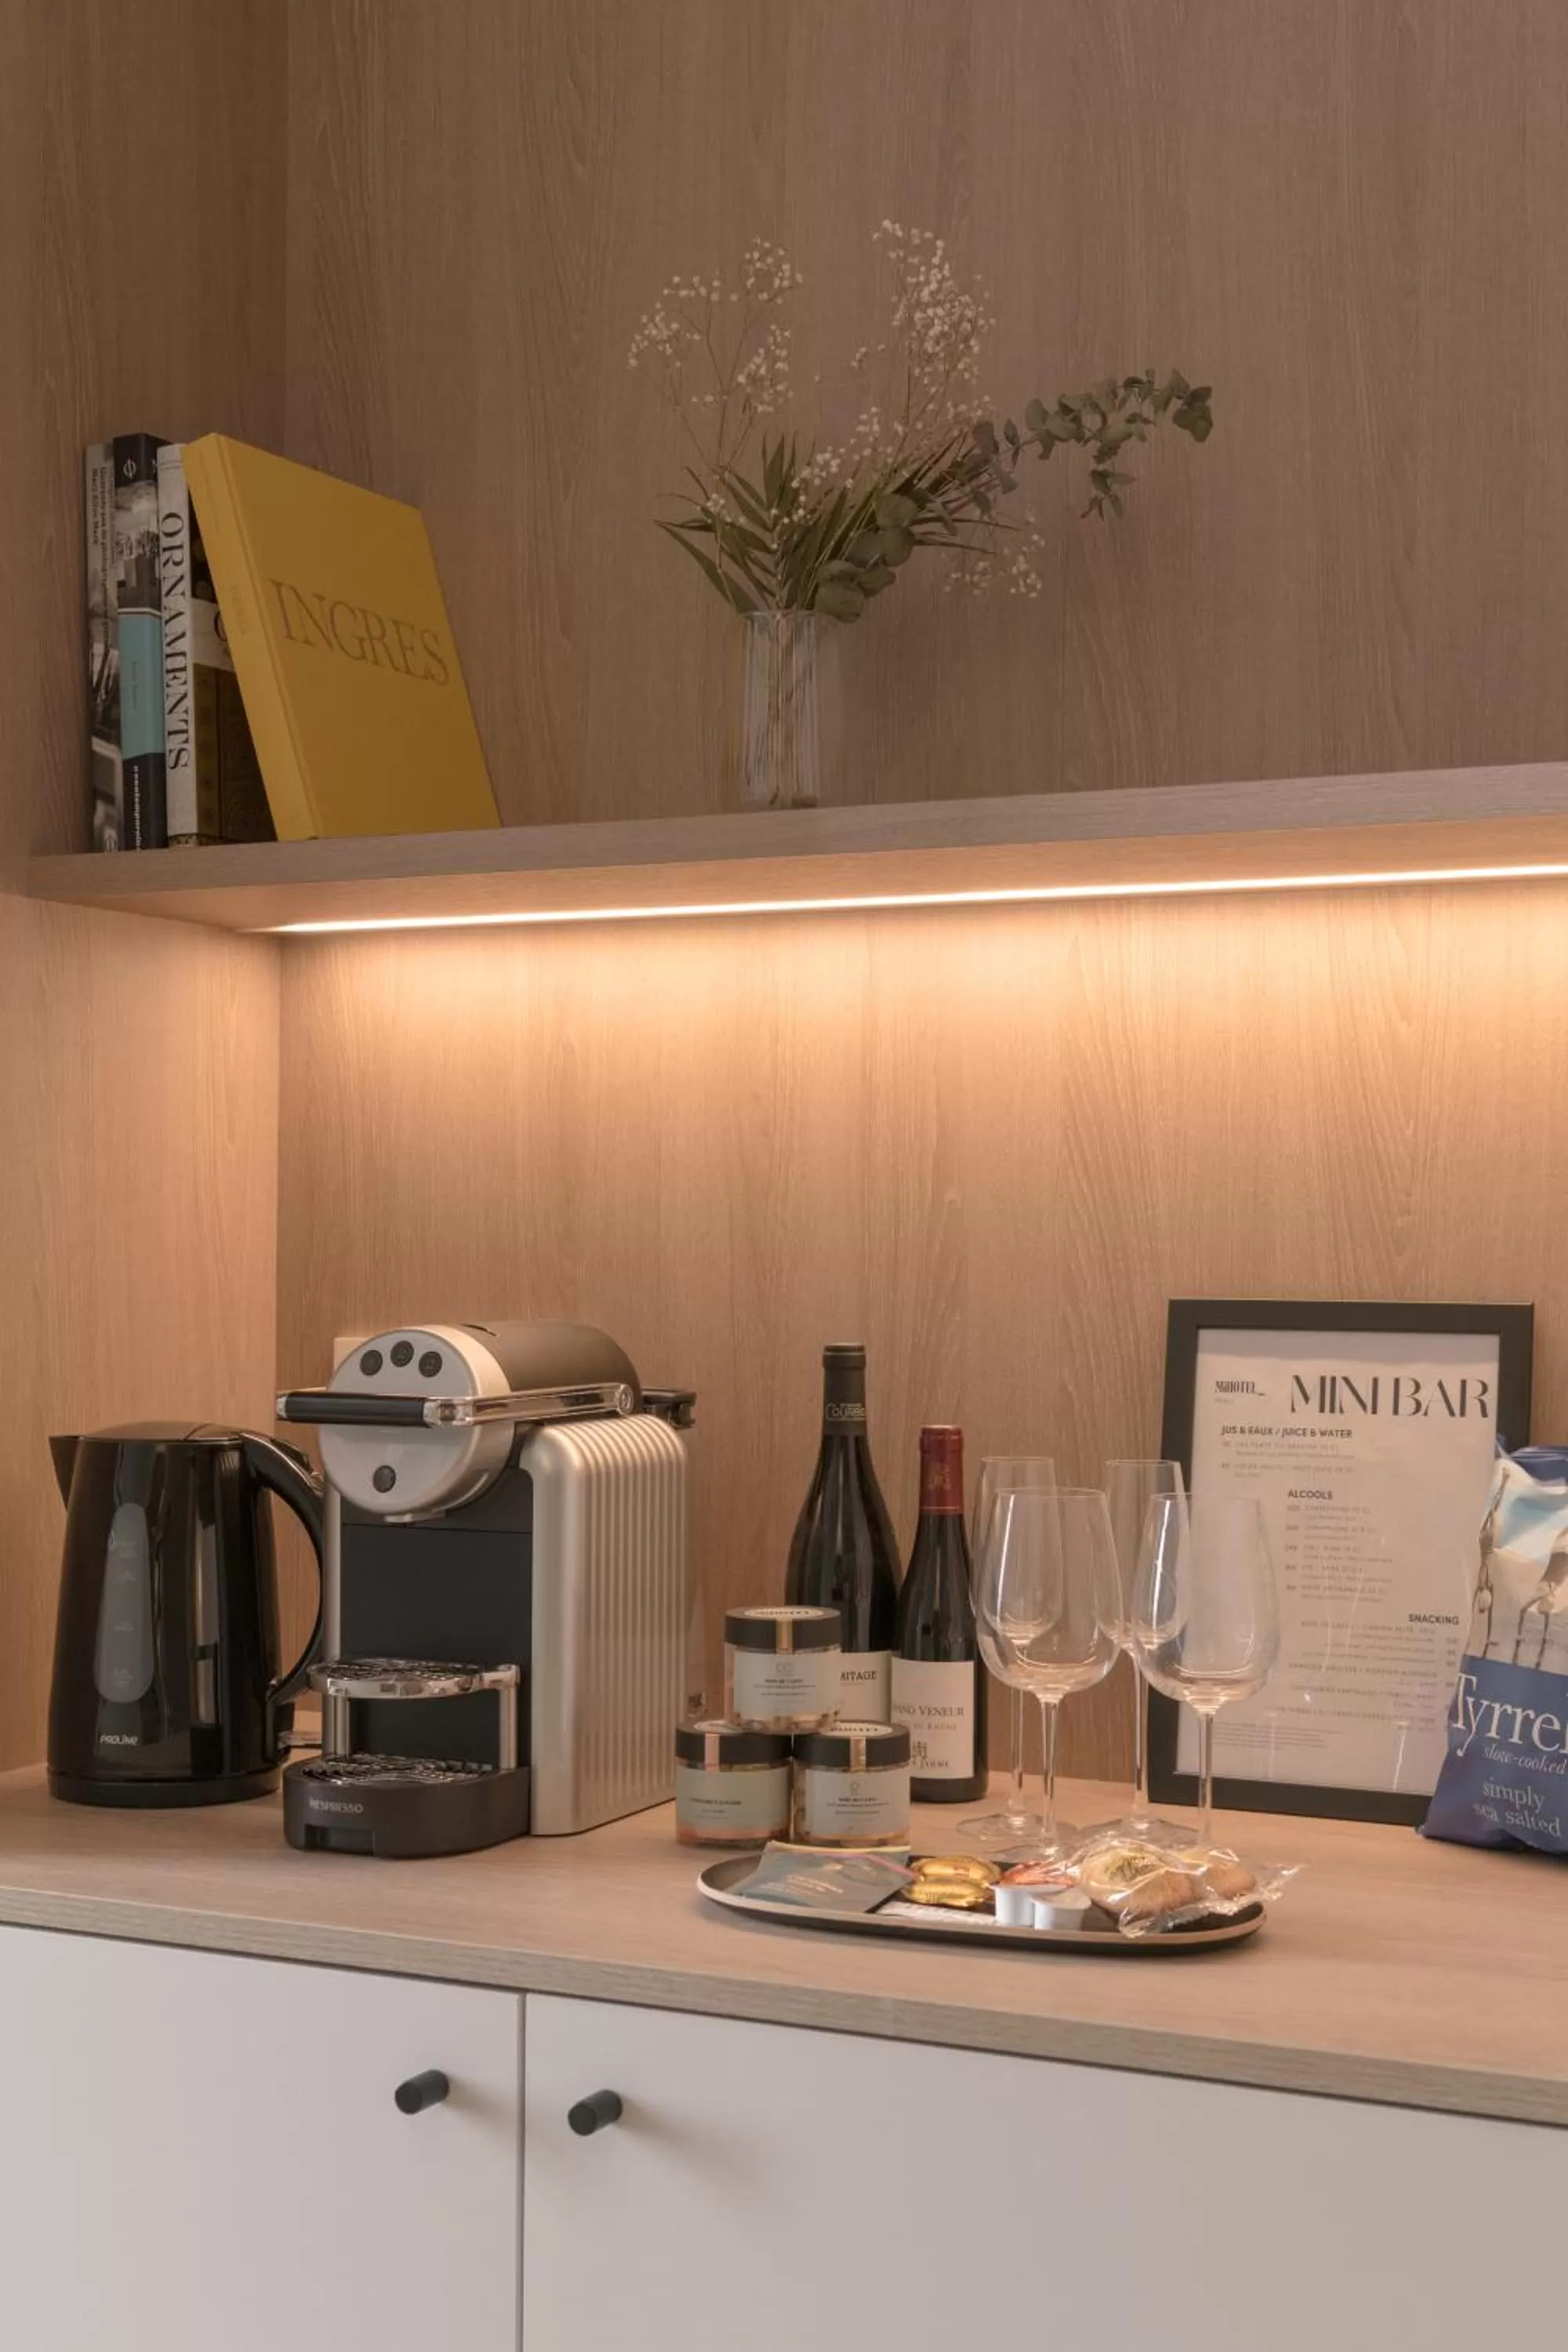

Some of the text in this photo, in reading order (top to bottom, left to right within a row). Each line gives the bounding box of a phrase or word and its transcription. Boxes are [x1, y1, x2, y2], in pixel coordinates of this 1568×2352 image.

[158, 512, 191, 771] ORNAMENTS
[267, 579, 451, 686] INGRES
[1290, 1373, 1490, 1418] MINI BAR
[1221, 1425, 1238, 1436] JUS
[1247, 1425, 1274, 1436] EAUX
[1281, 1427, 1307, 1438] JUICE
[1319, 1429, 1352, 1439] WATER
[1287, 1489, 1333, 1501] ALCOOLS
[1407, 1613, 1460, 1626] SNACKING
[1482, 1776, 1545, 1814] simply
[1471, 1803, 1563, 1838] sea salted
